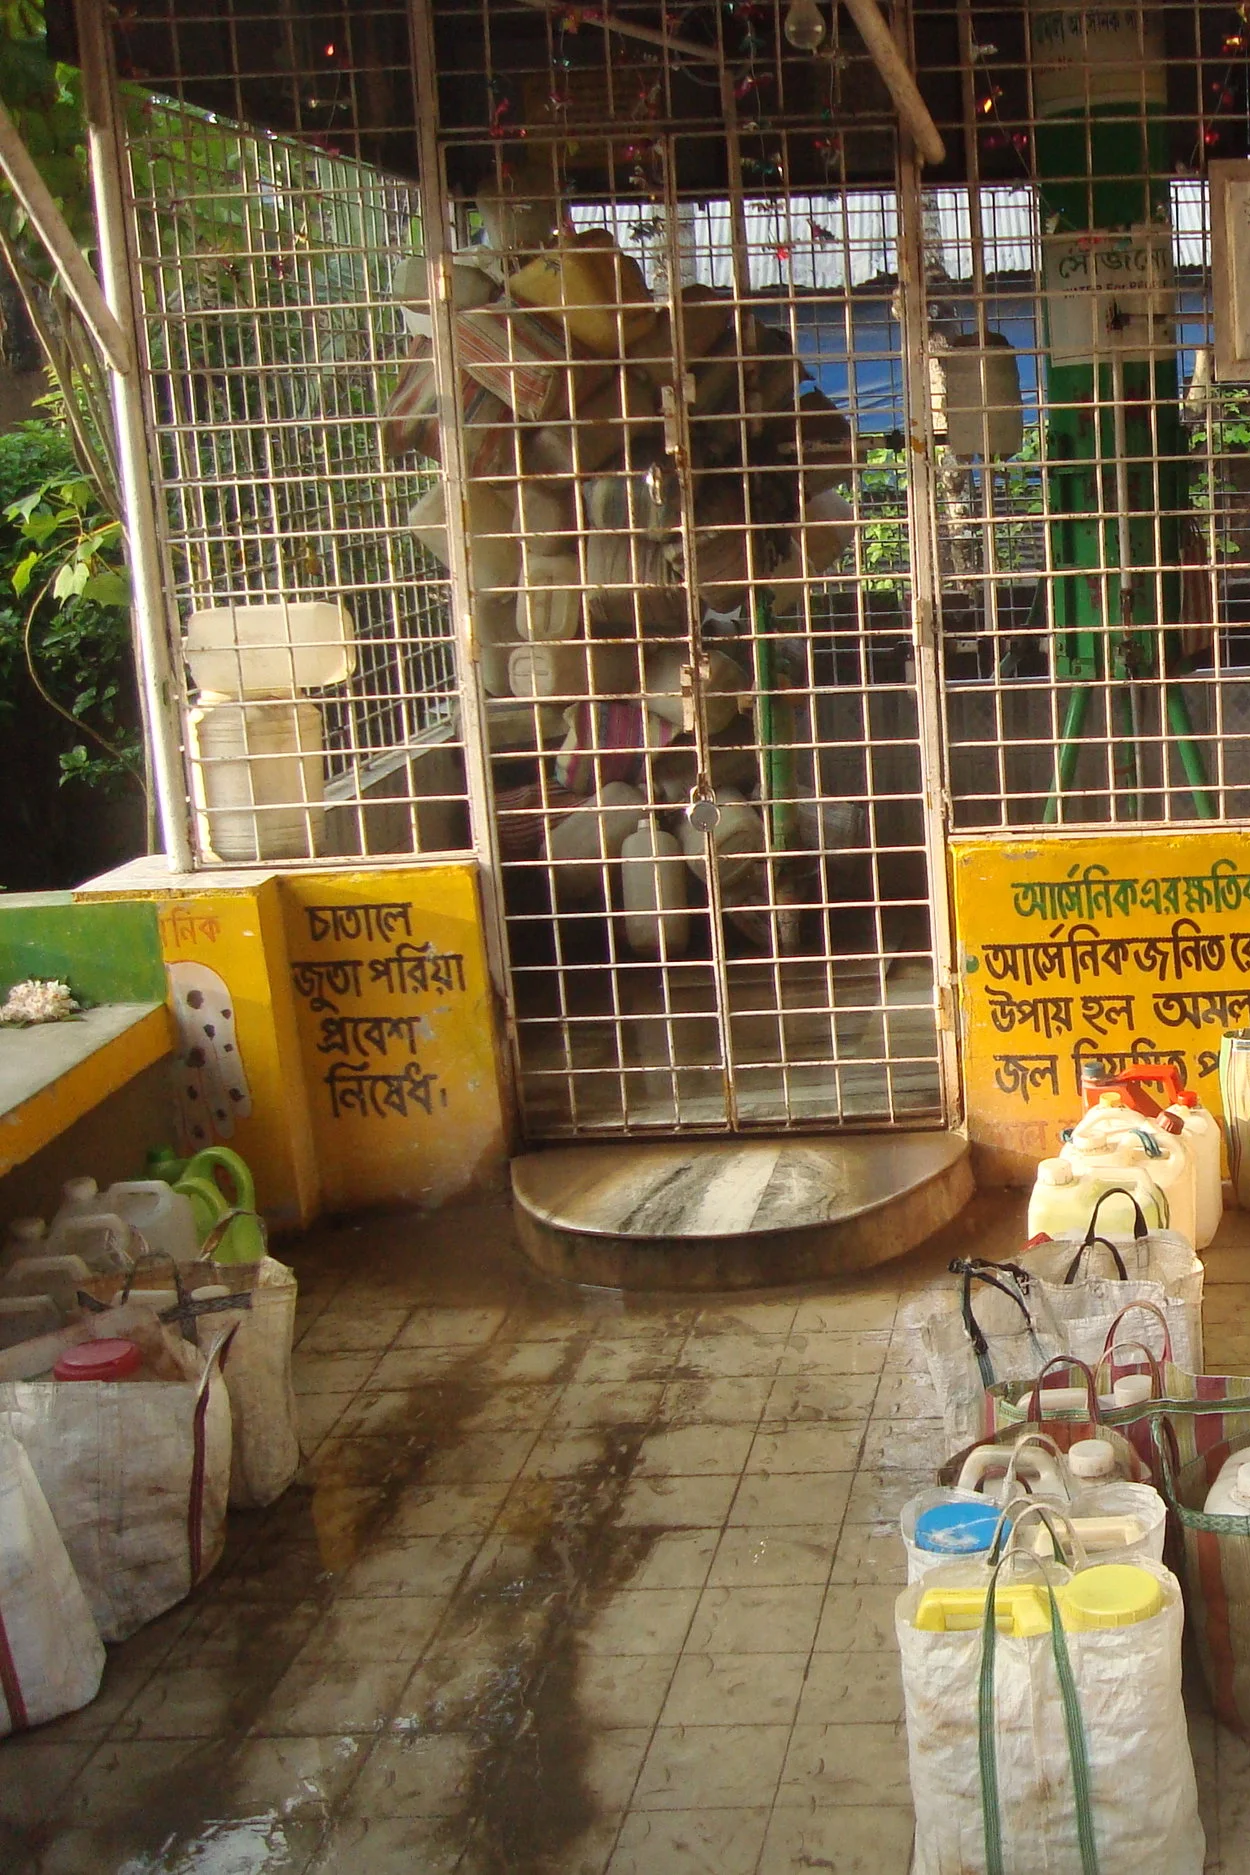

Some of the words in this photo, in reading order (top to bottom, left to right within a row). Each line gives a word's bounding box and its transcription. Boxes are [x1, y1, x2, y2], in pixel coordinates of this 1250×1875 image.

[304, 901, 413, 942] চাতালে
[292, 960, 363, 1014] জুতা
[369, 942, 467, 994] পরিয়া
[316, 1015, 421, 1056] প্রবেশ
[984, 985, 1074, 1039] উপায়
[1080, 995, 1136, 1036] হল
[993, 1053, 1059, 1105] জল
